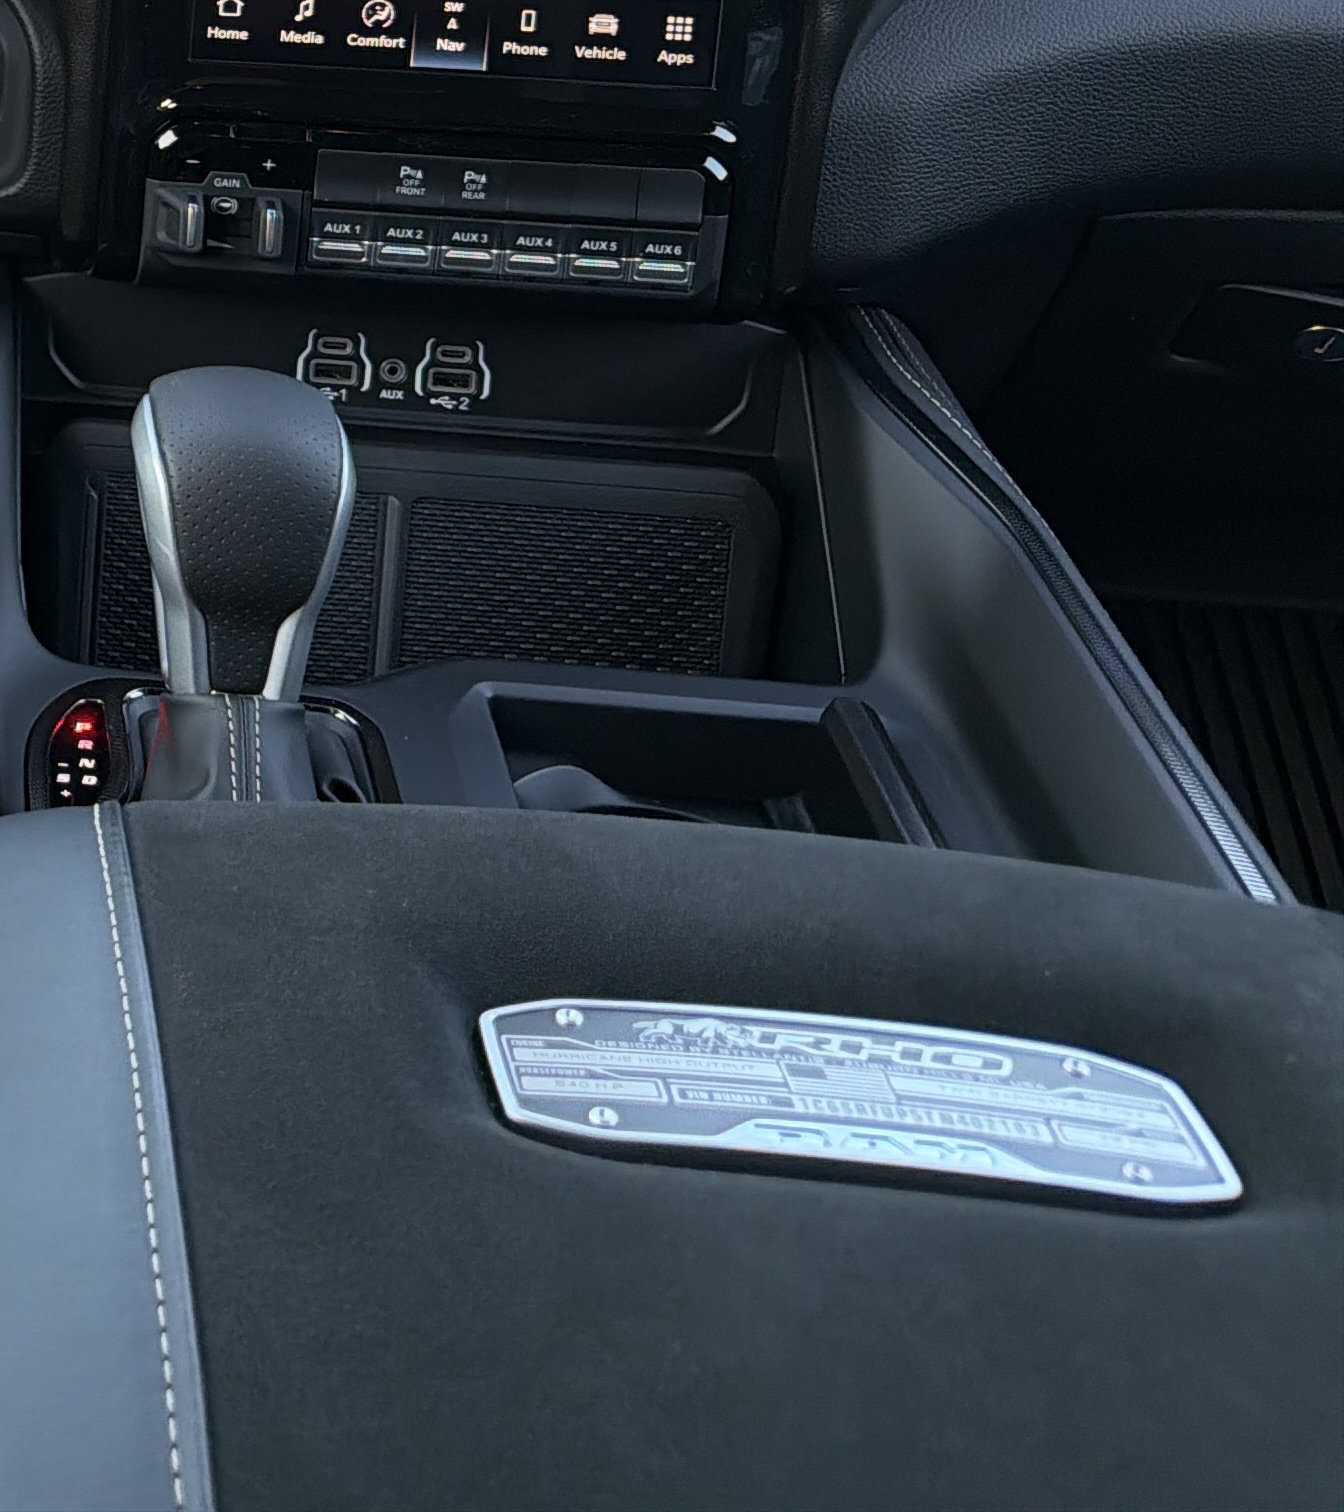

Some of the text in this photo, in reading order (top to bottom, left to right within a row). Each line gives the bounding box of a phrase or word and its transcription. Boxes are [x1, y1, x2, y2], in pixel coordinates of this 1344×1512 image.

[207, 26, 250, 41] Home
[279, 30, 325, 45] Media
[346, 34, 406, 49] Comfort
[436, 38, 466, 52] Nav
[502, 41, 549, 57] Phone
[574, 45, 627, 61] Vehicle
[656, 50, 694, 66] Apps
[213, 177, 241, 188] GAIN
[402, 178, 421, 187] OFF
[465, 183, 483, 191] OFF
[395, 186, 426, 196] FRONT
[462, 191, 486, 200] REAR
[323, 222, 361, 234] AUX 1
[387, 227, 423, 239] AUX 2
[452, 231, 488, 243] AUX 3
[516, 236, 553, 247] AUX 4
[581, 240, 617, 251] AUX 5
[645, 244, 682, 255] AUX 6
[379, 389, 405, 400] AUX
[77, 739, 94, 750] R
[594, 1039, 684, 1053] DESIGNED
[688, 1044, 712, 1056] BY
[532, 1050, 756, 1073] HURRICANE HIGH OUTPUT
